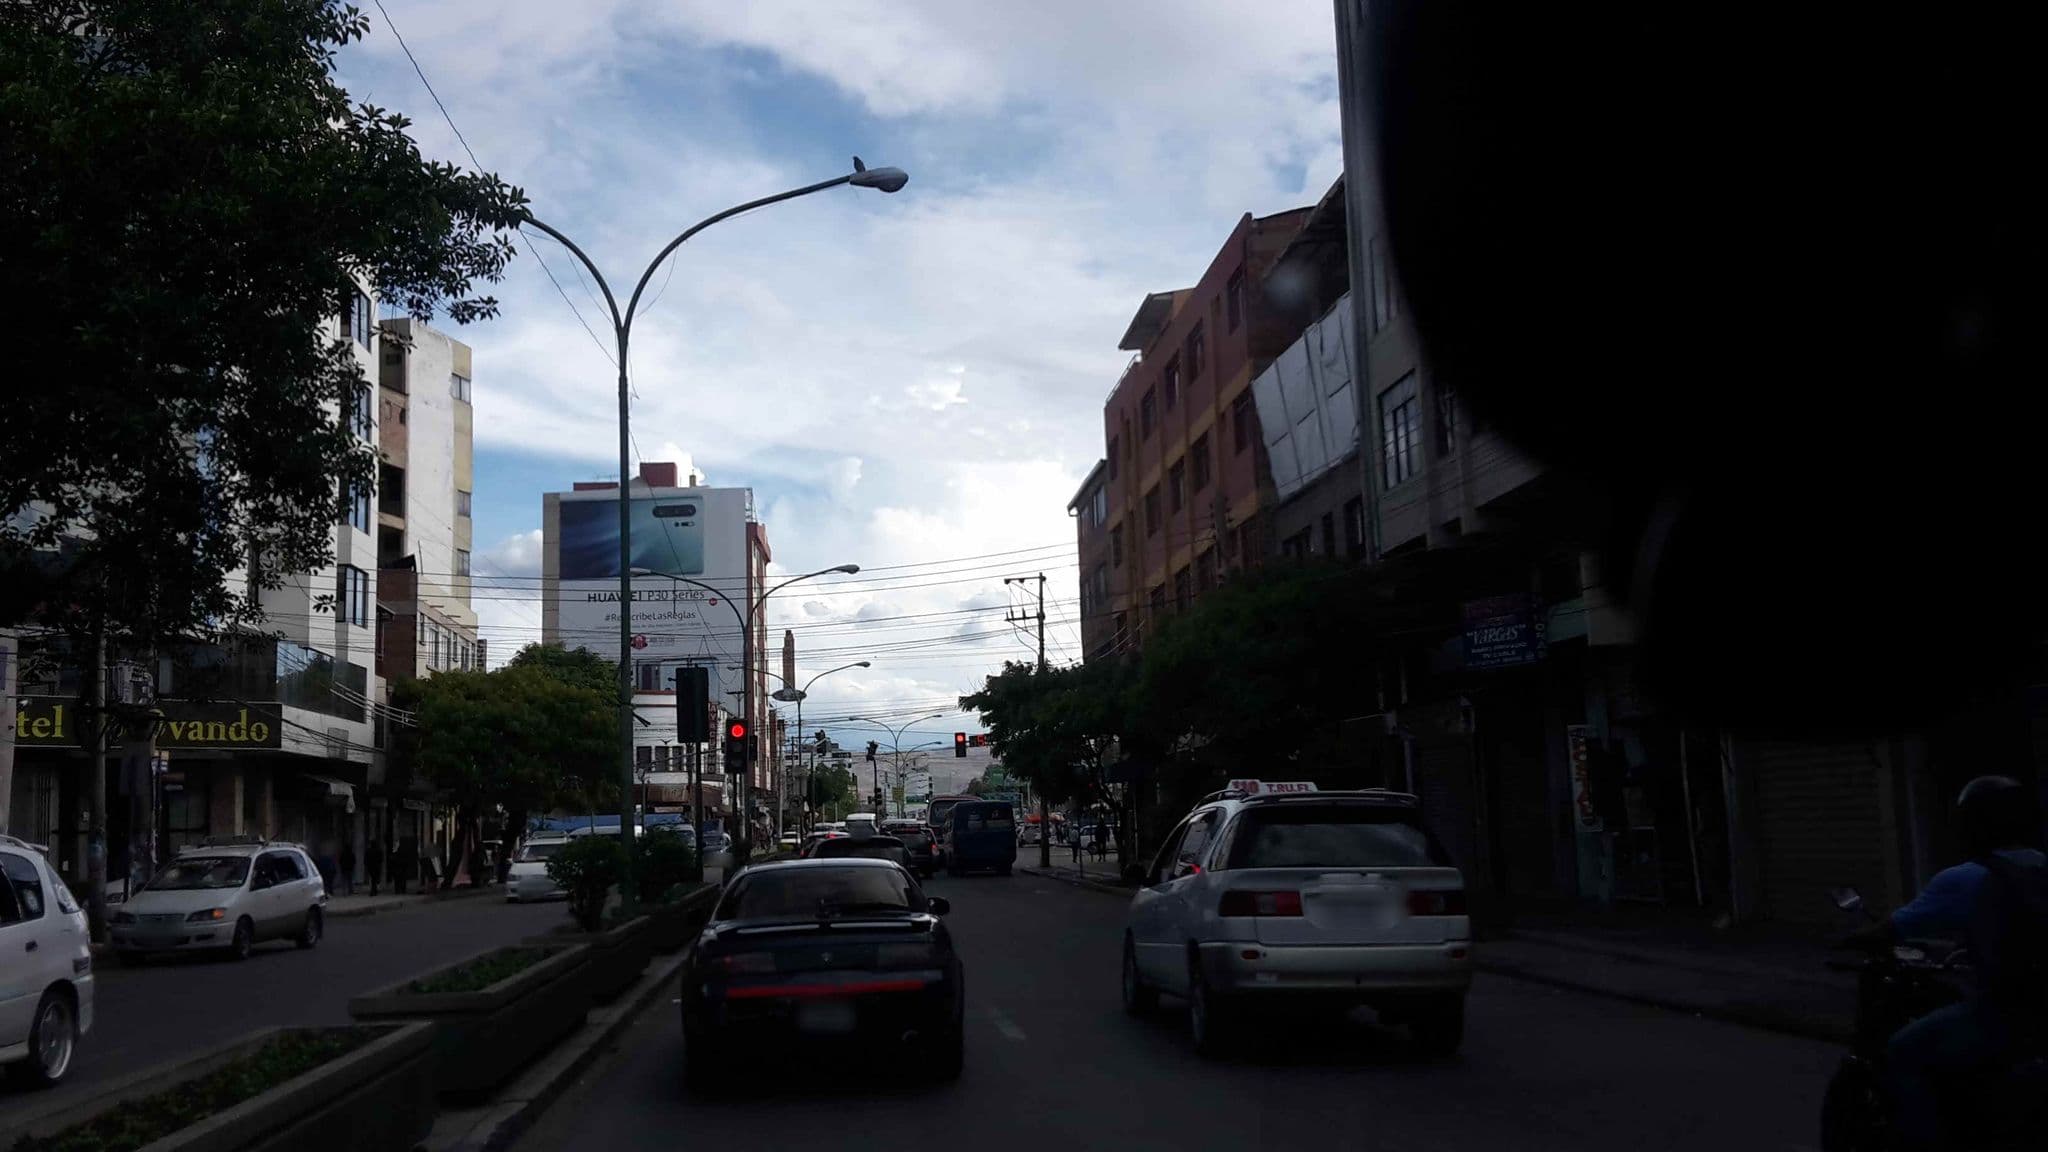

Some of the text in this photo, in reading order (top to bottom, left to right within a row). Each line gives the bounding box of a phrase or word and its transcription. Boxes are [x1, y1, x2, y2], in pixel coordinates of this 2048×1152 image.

[648, 590, 669, 601] P30
[673, 590, 705, 601] Series
[605, 610, 696, 622] #RecribeLasReglas
